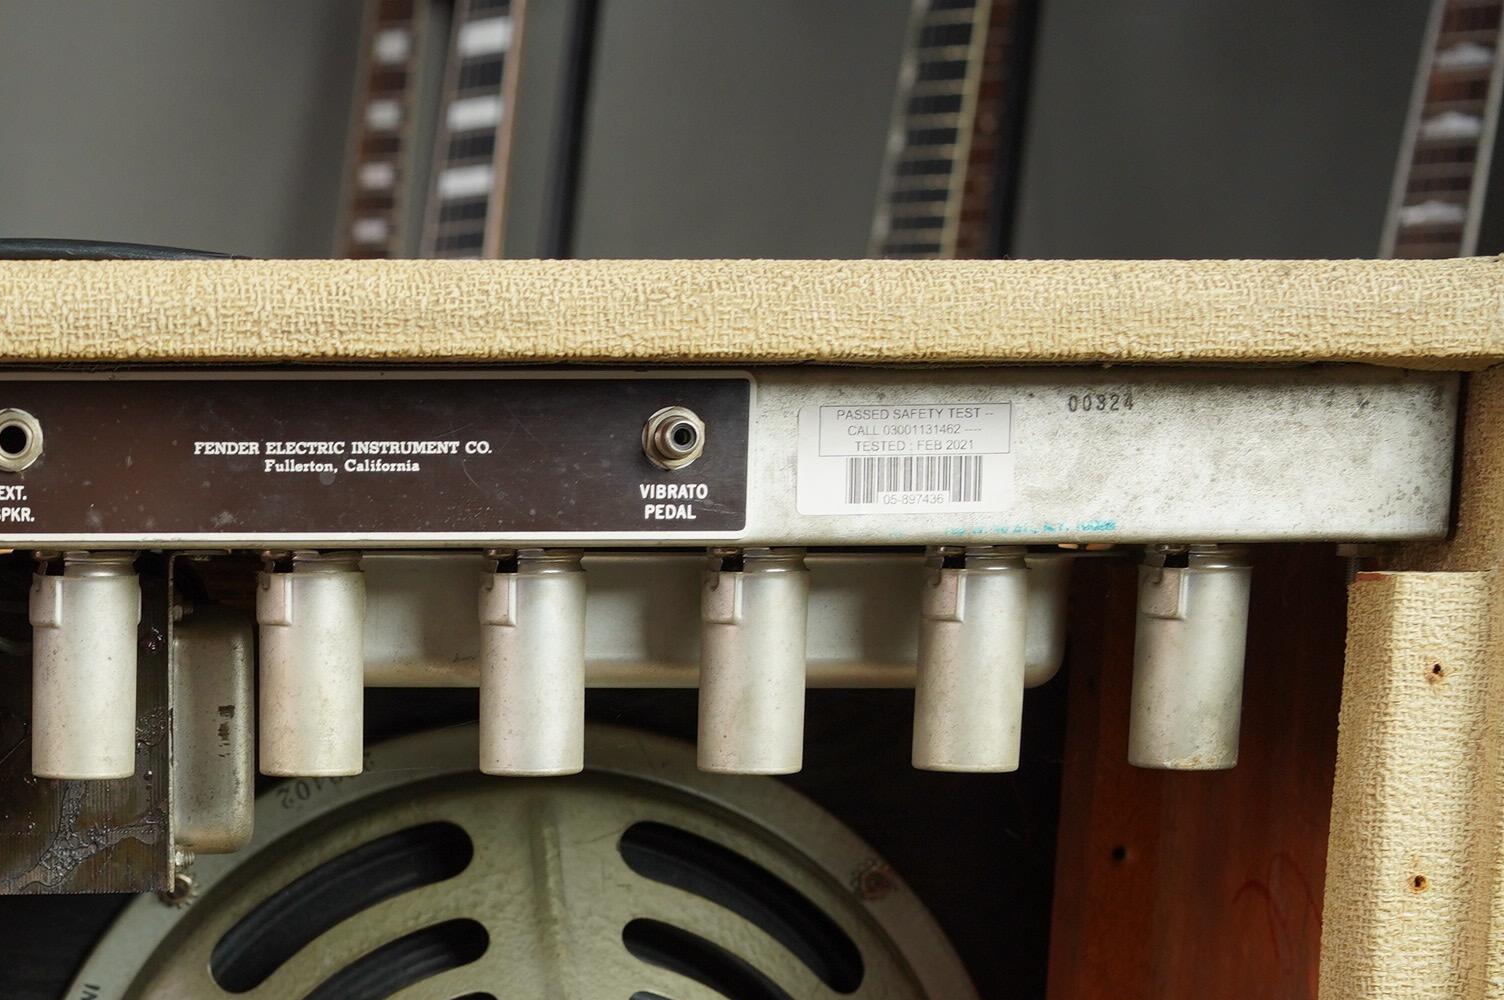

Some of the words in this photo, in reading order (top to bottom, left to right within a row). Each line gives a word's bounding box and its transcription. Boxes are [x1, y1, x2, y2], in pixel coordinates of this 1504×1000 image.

[1068, 392, 1133, 412] 00324
[836, 409, 890, 421] PASSED
[892, 408, 945, 420] SAFETY
[949, 407, 981, 419] TEST
[847, 425, 880, 436] CALL
[194, 441, 260, 456] FENDER
[265, 441, 345, 455] ELECTRIC
[351, 440, 460, 455] INSTRUMENT
[465, 440, 493, 454] CO.
[855, 440, 905, 452] TESTED
[916, 440, 943, 451] FEB
[945, 439, 974, 450] 2021
[264, 458, 338, 474] Fullerton,
[344, 458, 420, 473] California
[639, 483, 709, 499] VIBRATO
[644, 504, 697, 520] PEDAL
